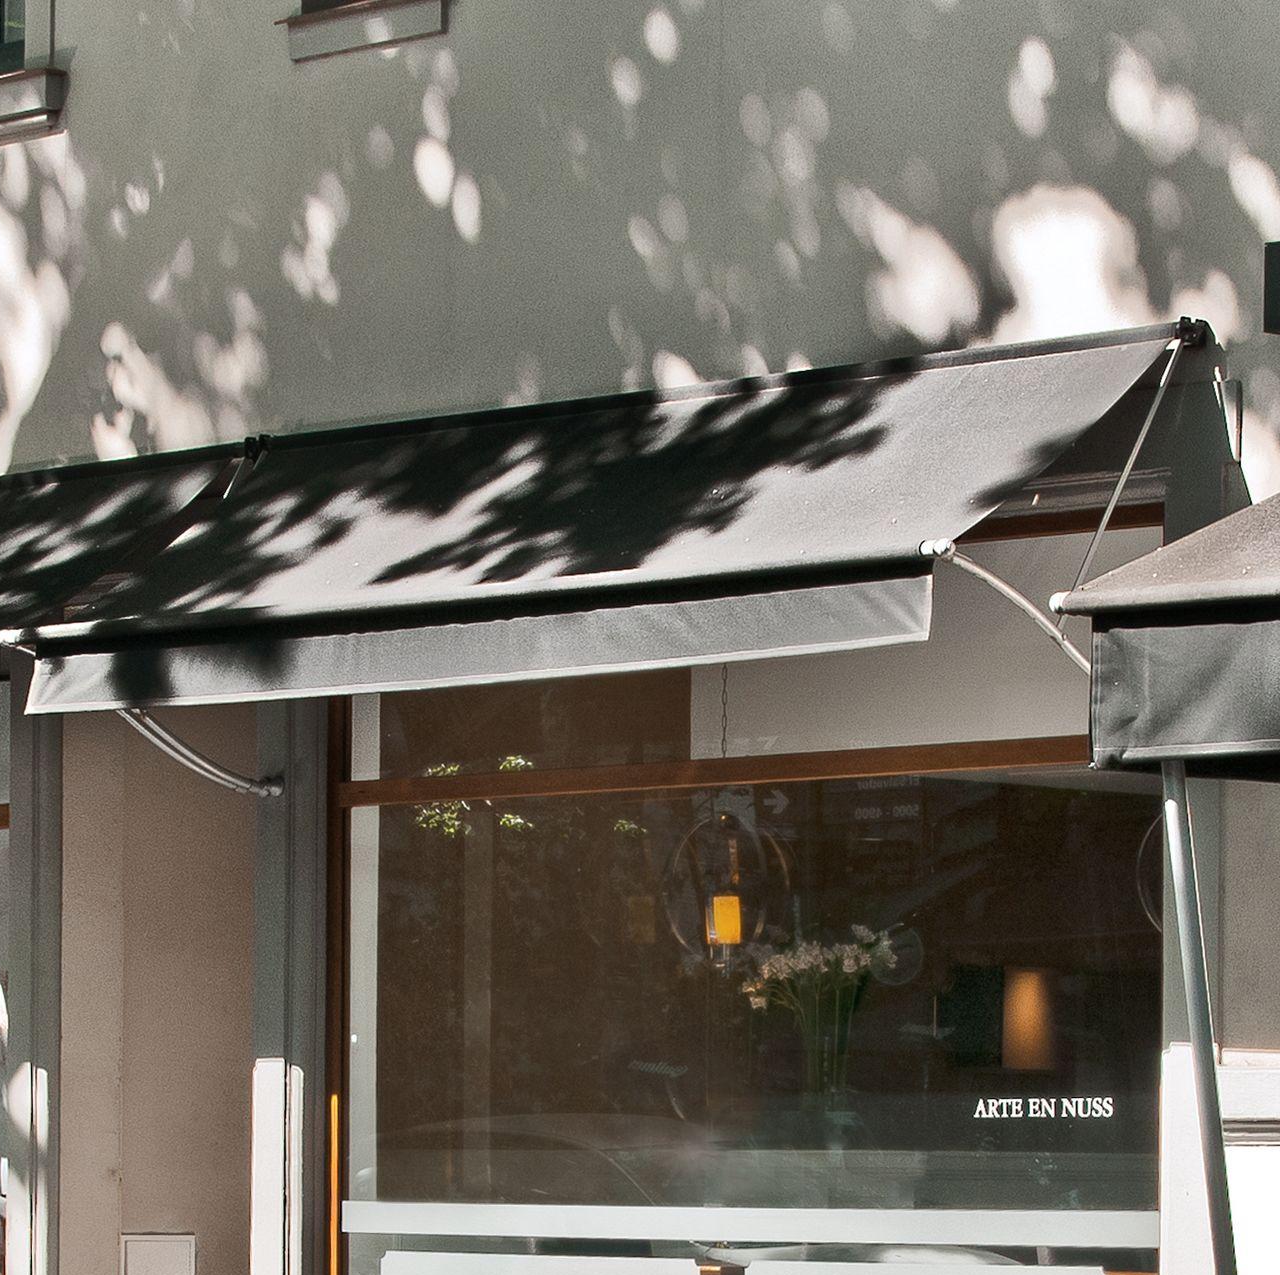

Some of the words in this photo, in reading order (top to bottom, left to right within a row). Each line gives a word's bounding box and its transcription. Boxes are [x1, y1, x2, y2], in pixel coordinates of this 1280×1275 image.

[973, 1098, 1024, 1118] ARTE
[1027, 1098, 1056, 1118] EN
[1061, 1097, 1114, 1118] NUSS
